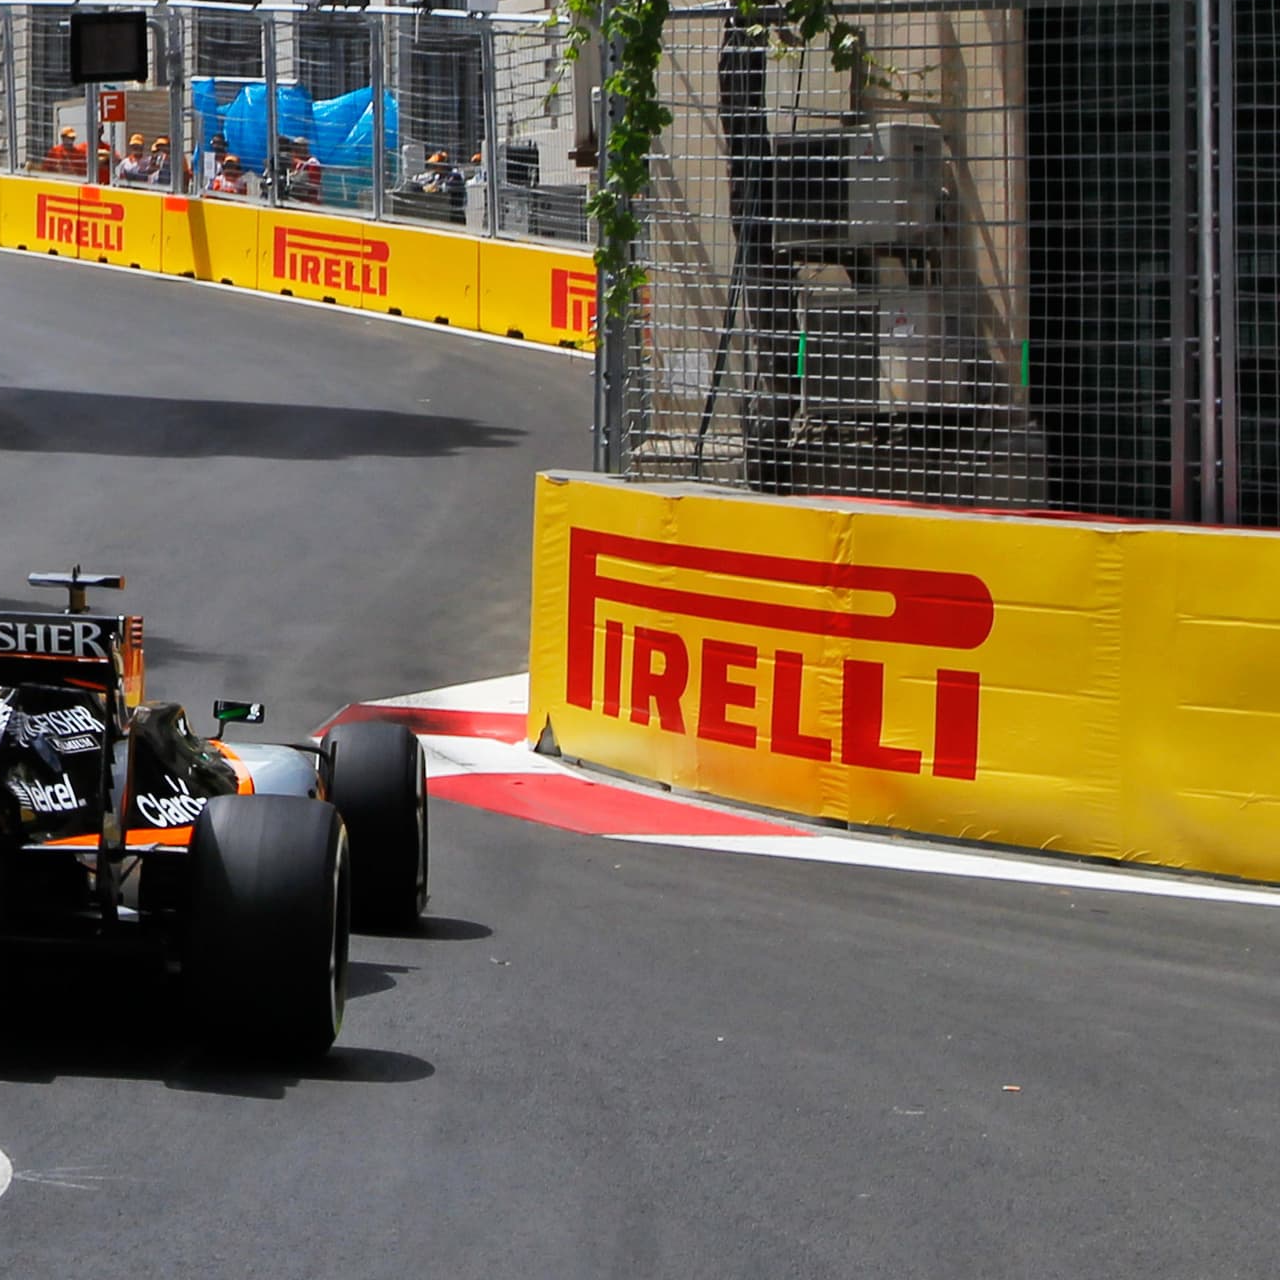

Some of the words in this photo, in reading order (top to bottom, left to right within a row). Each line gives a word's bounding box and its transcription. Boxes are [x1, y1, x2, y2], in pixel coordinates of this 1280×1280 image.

[103, 95, 119, 119] F
[36, 194, 125, 253] PIRELLI
[273, 226, 390, 297] PIRELLI
[566, 526, 995, 781] PIRELLI
